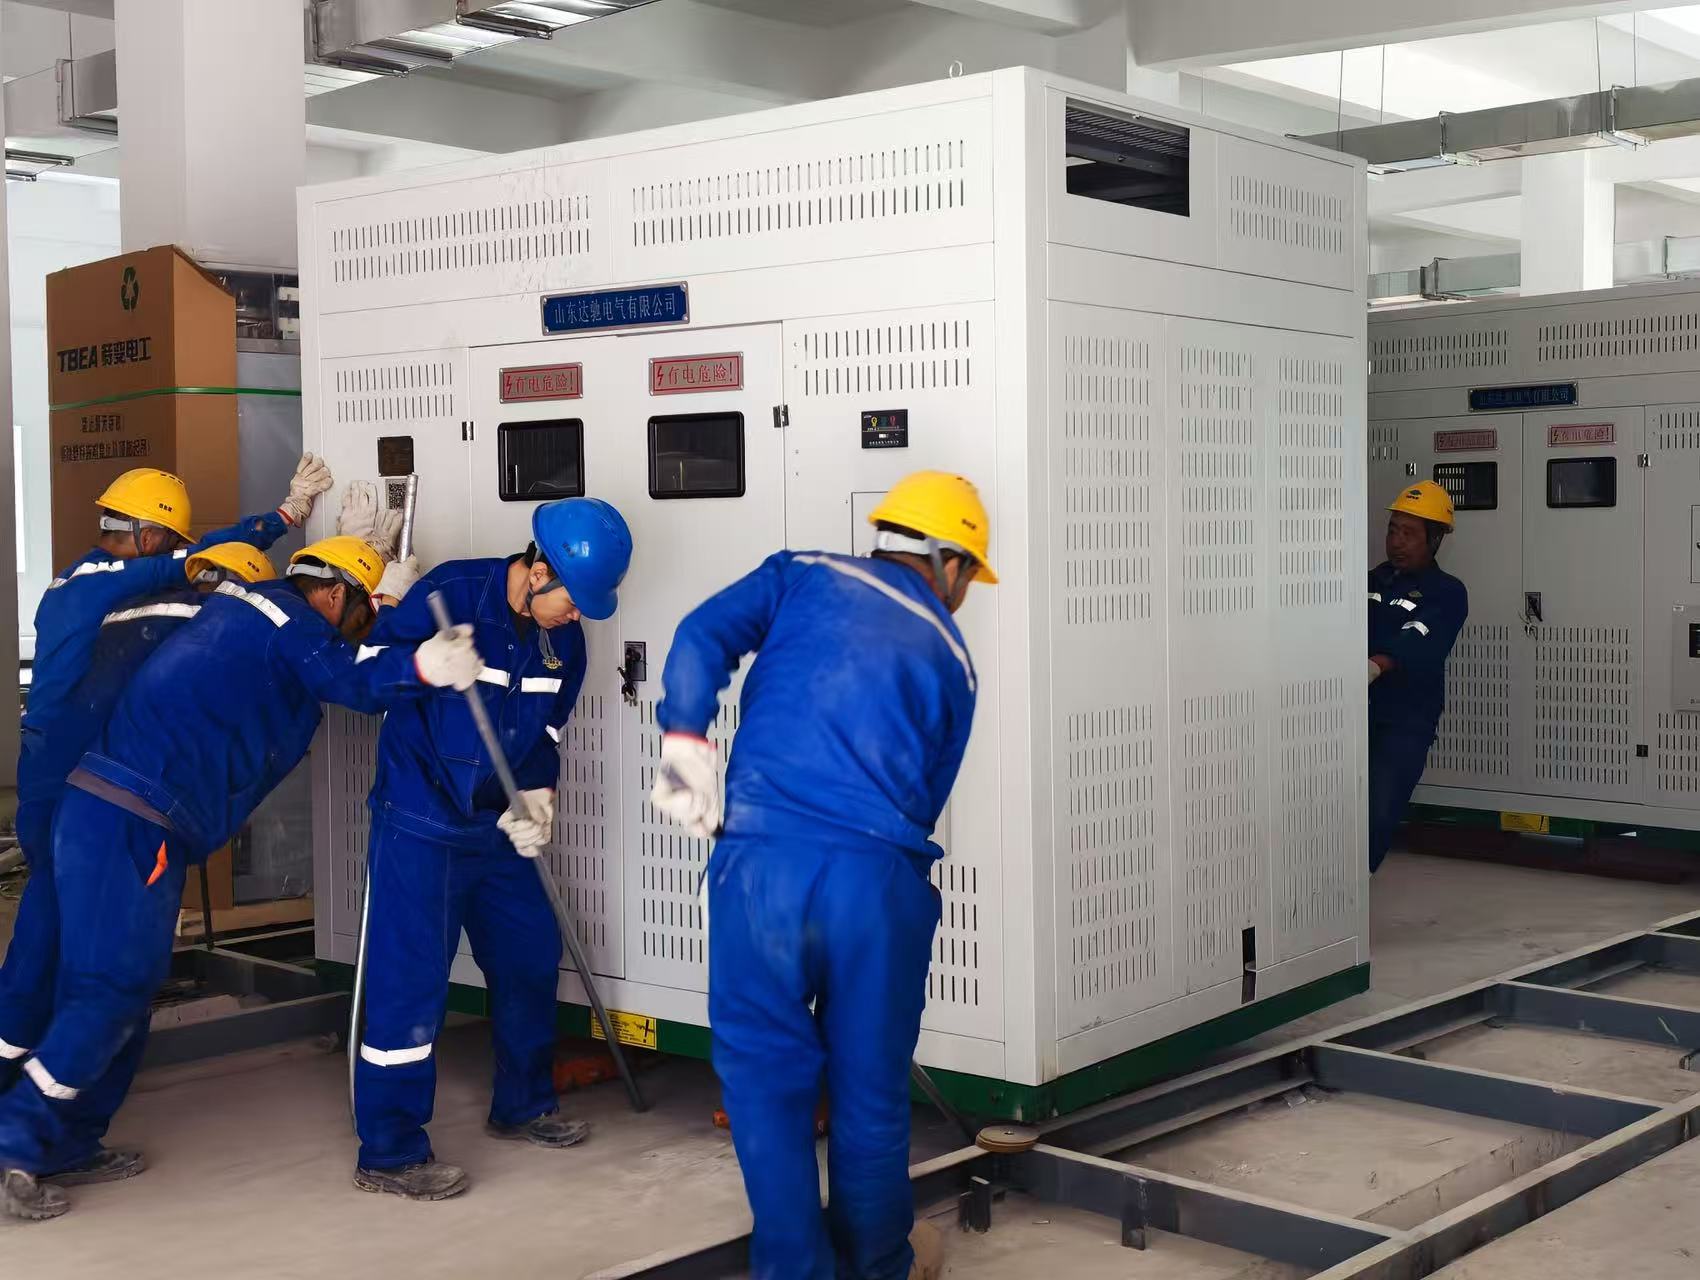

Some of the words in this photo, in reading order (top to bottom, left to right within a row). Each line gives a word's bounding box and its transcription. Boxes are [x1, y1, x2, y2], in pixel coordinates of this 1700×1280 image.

[554, 292, 676, 324] 山东达驰电气有限公司
[57, 345, 98, 373] TBEA
